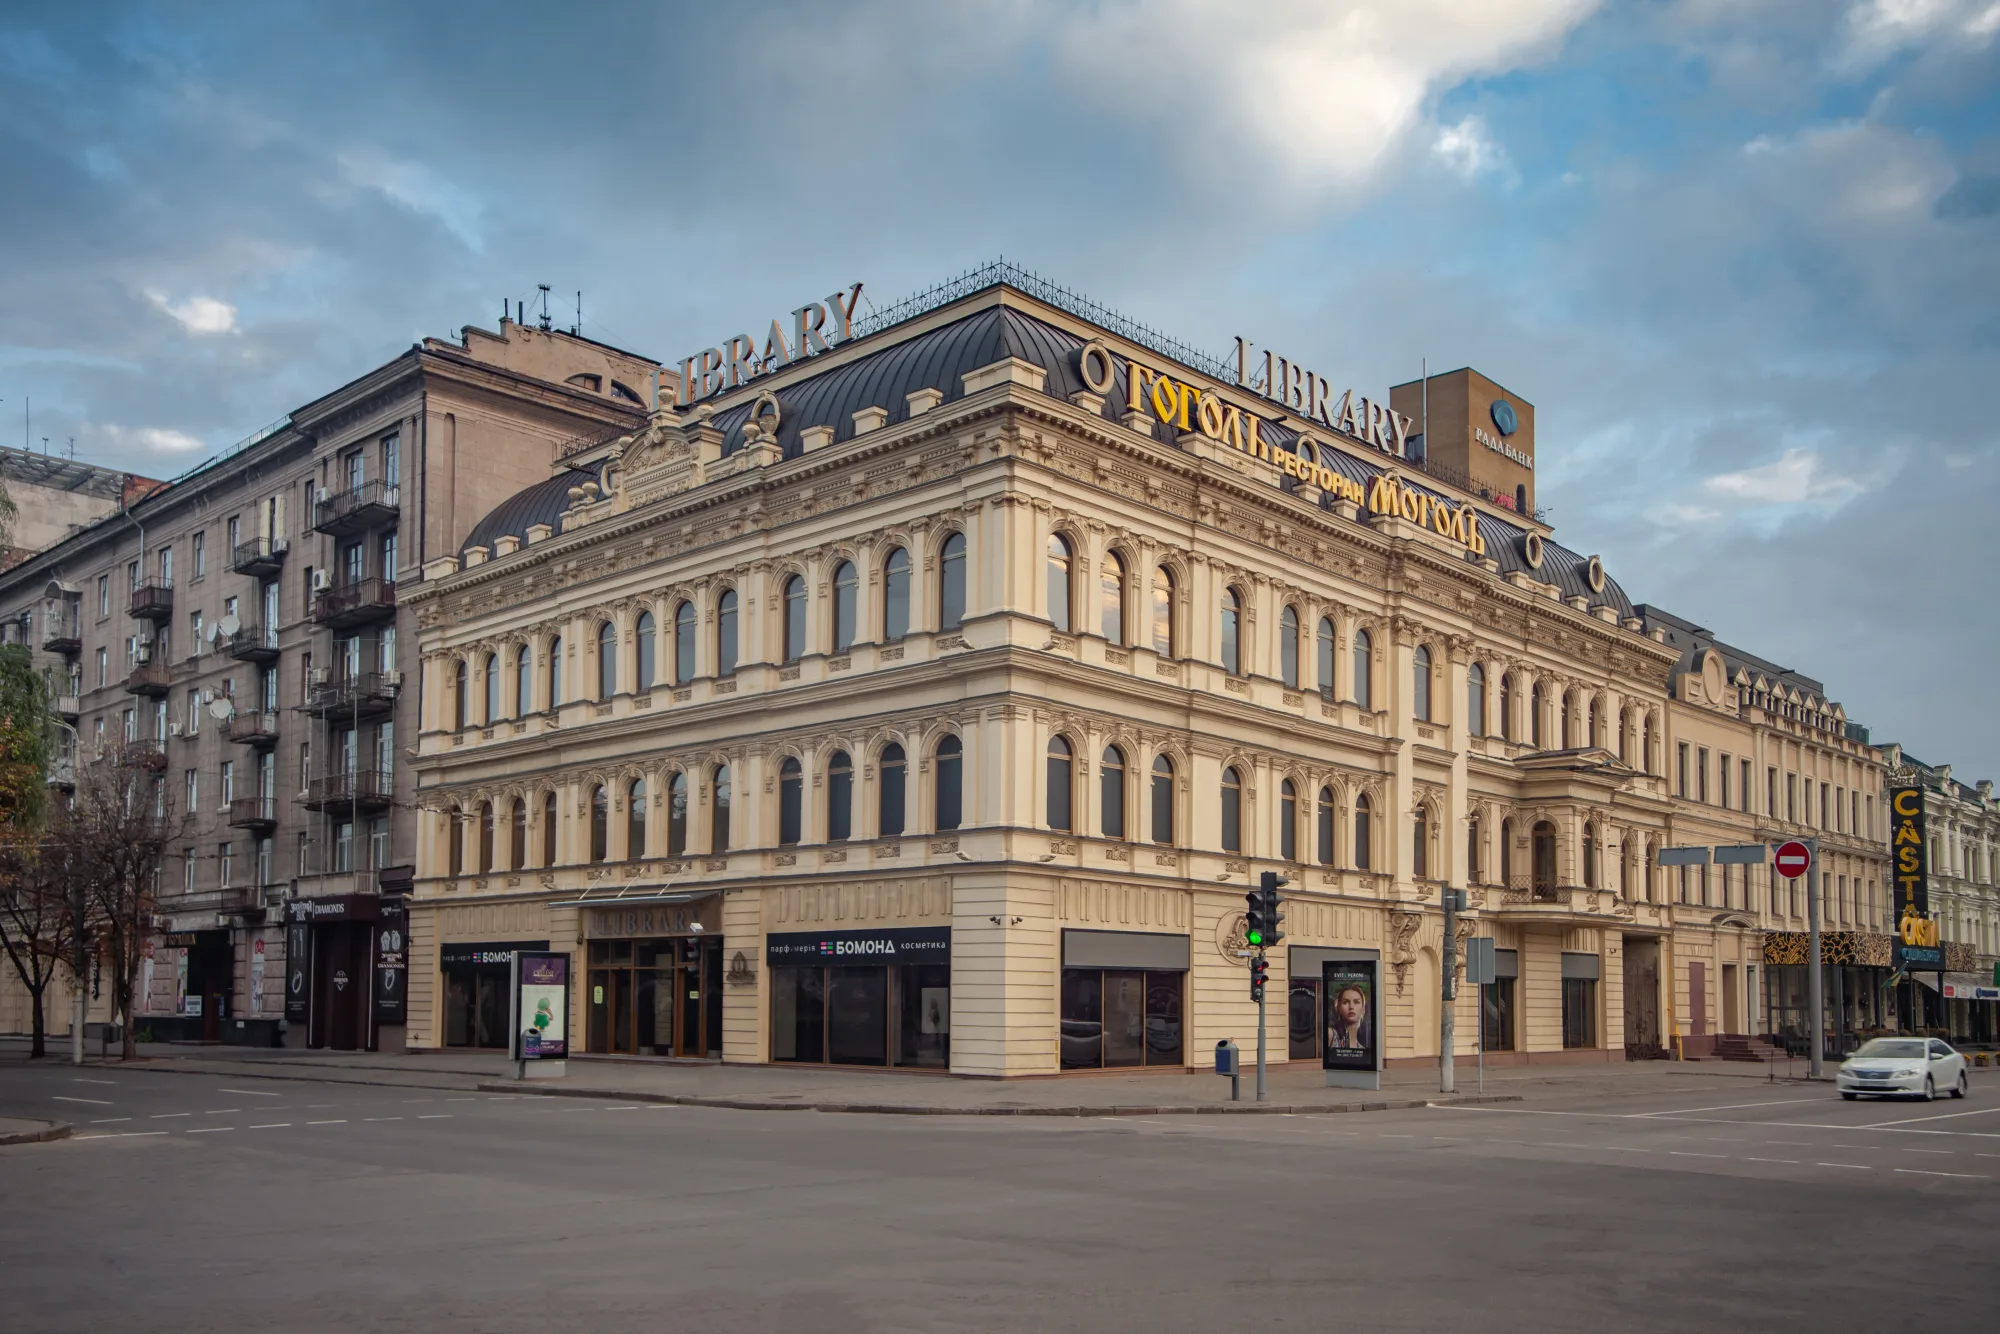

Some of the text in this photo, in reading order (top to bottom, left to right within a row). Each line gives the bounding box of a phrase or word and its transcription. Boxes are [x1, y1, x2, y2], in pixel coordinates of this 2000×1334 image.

[1234, 336, 1413, 459] LIBRARY
[1126, 360, 1269, 461] ГОГОЛЬ
[1271, 446, 1365, 507] РЕСТОРАН
[315, 903, 345, 915] DIAMONDS
[599, 908, 699, 935] LIBRARY
[482, 951, 511, 963] БОМОН
[770, 940, 946, 955] парфмерія БОМОНД косметика
